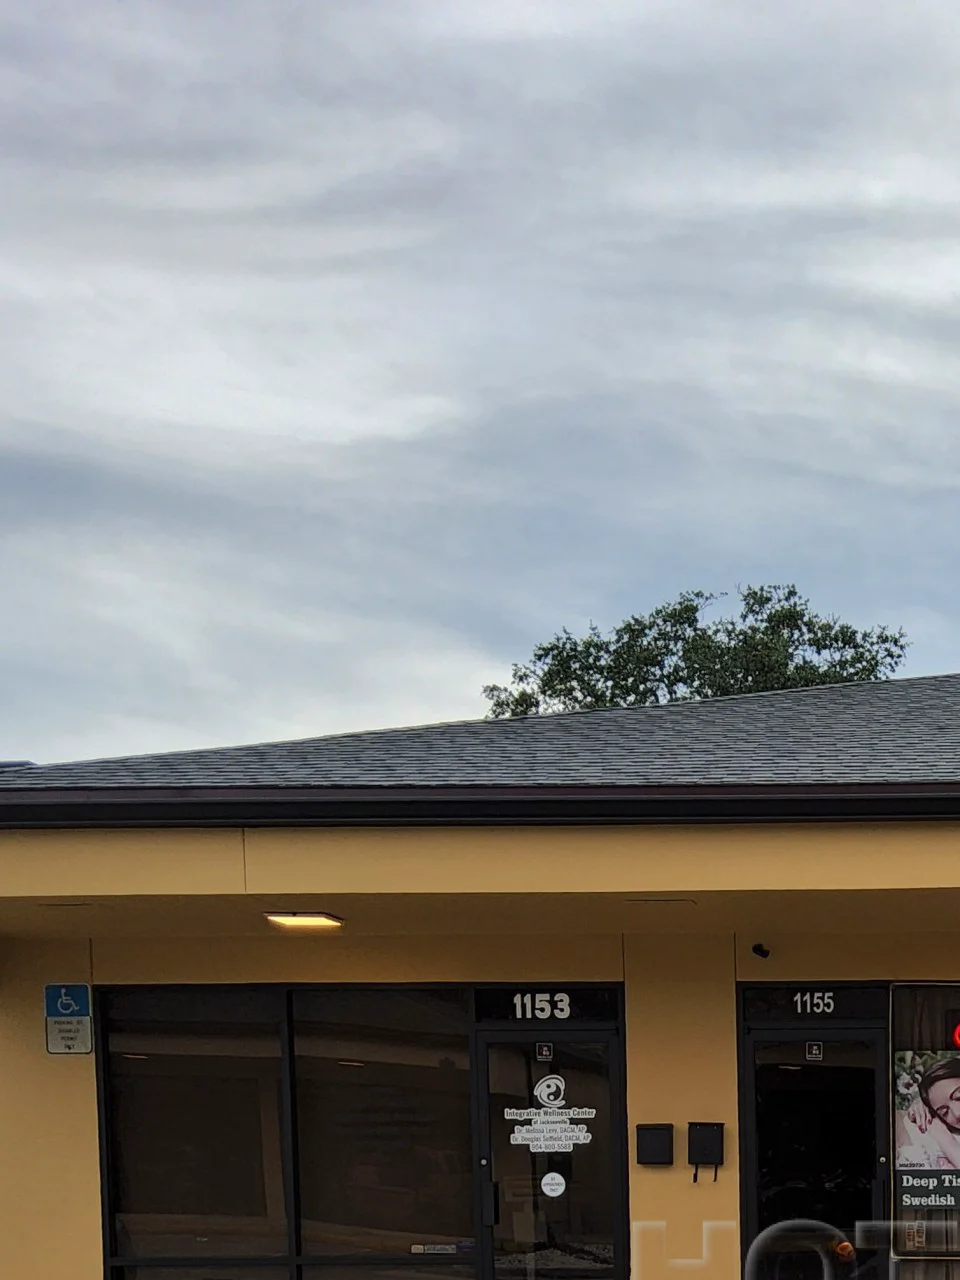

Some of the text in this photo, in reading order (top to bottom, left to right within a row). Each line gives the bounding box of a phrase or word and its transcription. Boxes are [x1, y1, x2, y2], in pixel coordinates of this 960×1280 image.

[513, 992, 571, 1019] 1153
[794, 991, 835, 1014] 1155
[506, 1109, 595, 1119] Integrative Wellness Center
[583, 1133, 591, 1141] AP
[902, 1175, 938, 1190] Deep
[902, 1193, 956, 1206] Swedish
